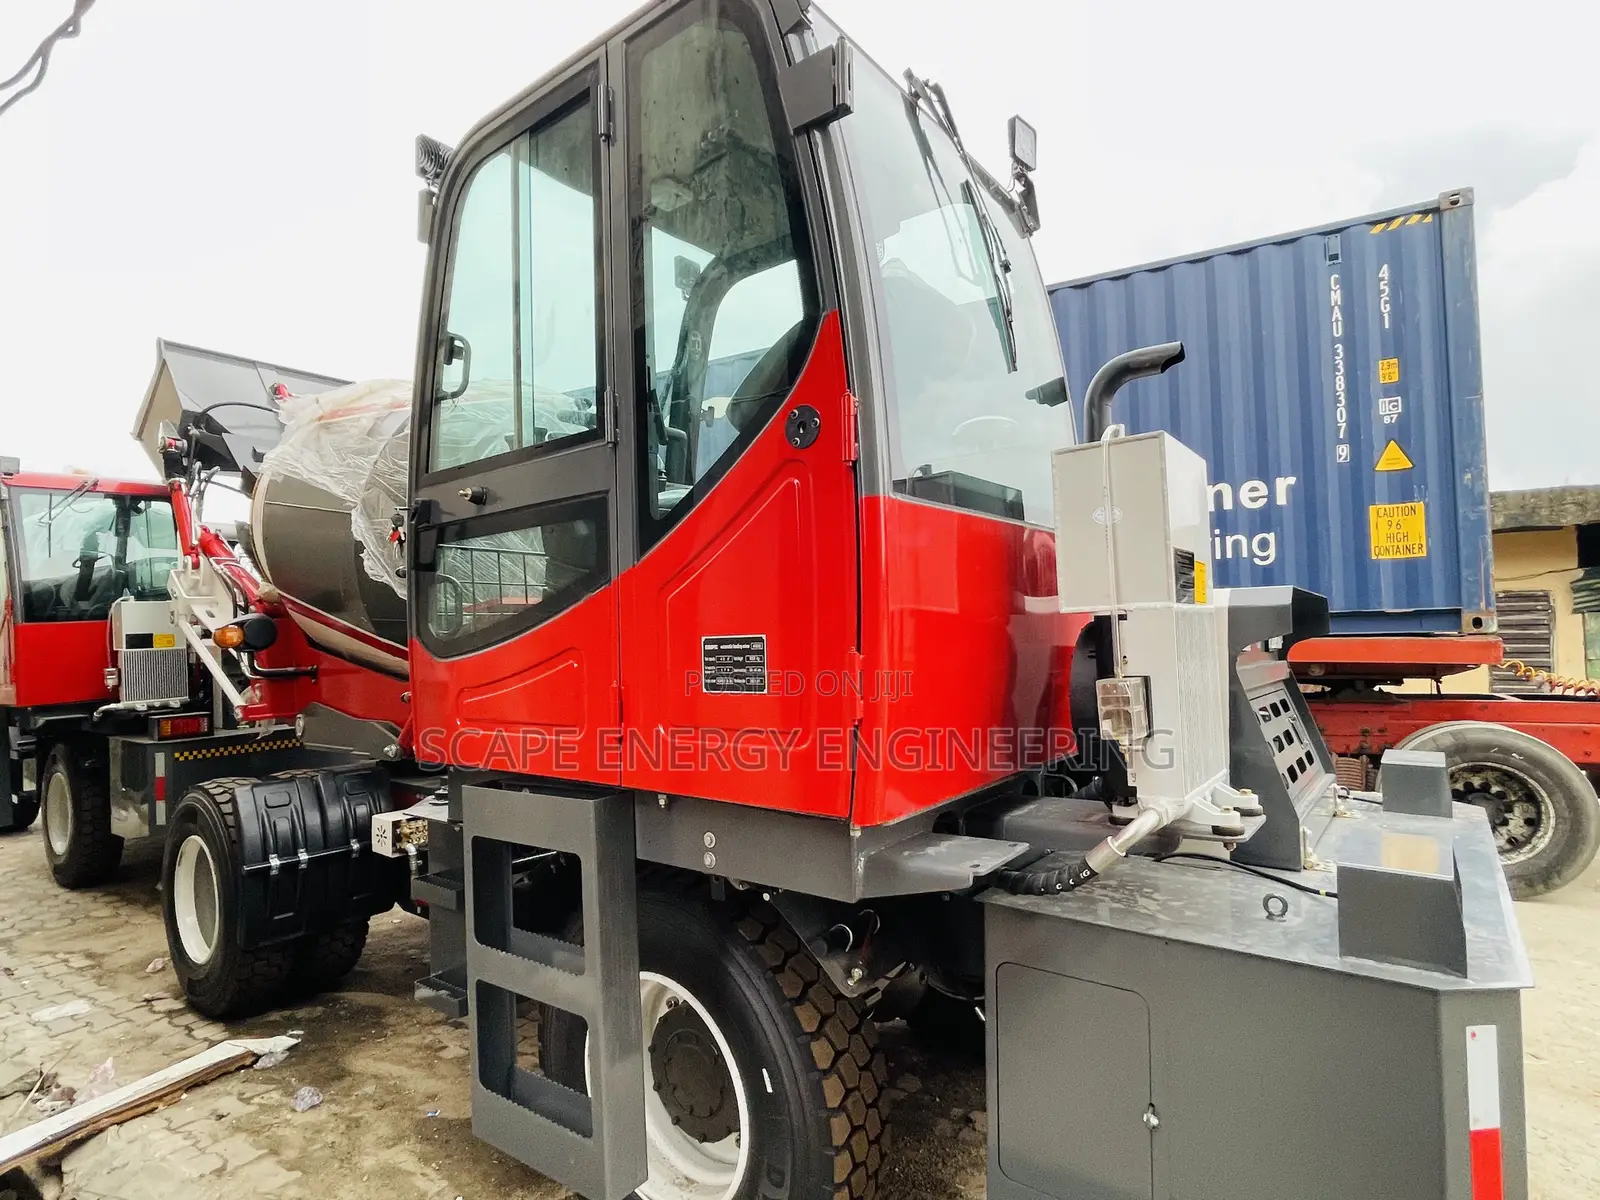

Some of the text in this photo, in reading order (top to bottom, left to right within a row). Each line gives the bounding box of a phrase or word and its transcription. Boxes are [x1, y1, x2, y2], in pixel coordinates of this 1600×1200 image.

[1378, 263, 1391, 329] 45G1
[1330, 273, 1347, 462] CMAU 338307 9
[1383, 414, 1399, 425] 87
[1207, 476, 1297, 512] ner
[1376, 505, 1417, 519] CAUTION
[1209, 528, 1276, 566] ing
[1373, 543, 1424, 557] CONTAINER
[1385, 531, 1409, 544] HIGH
